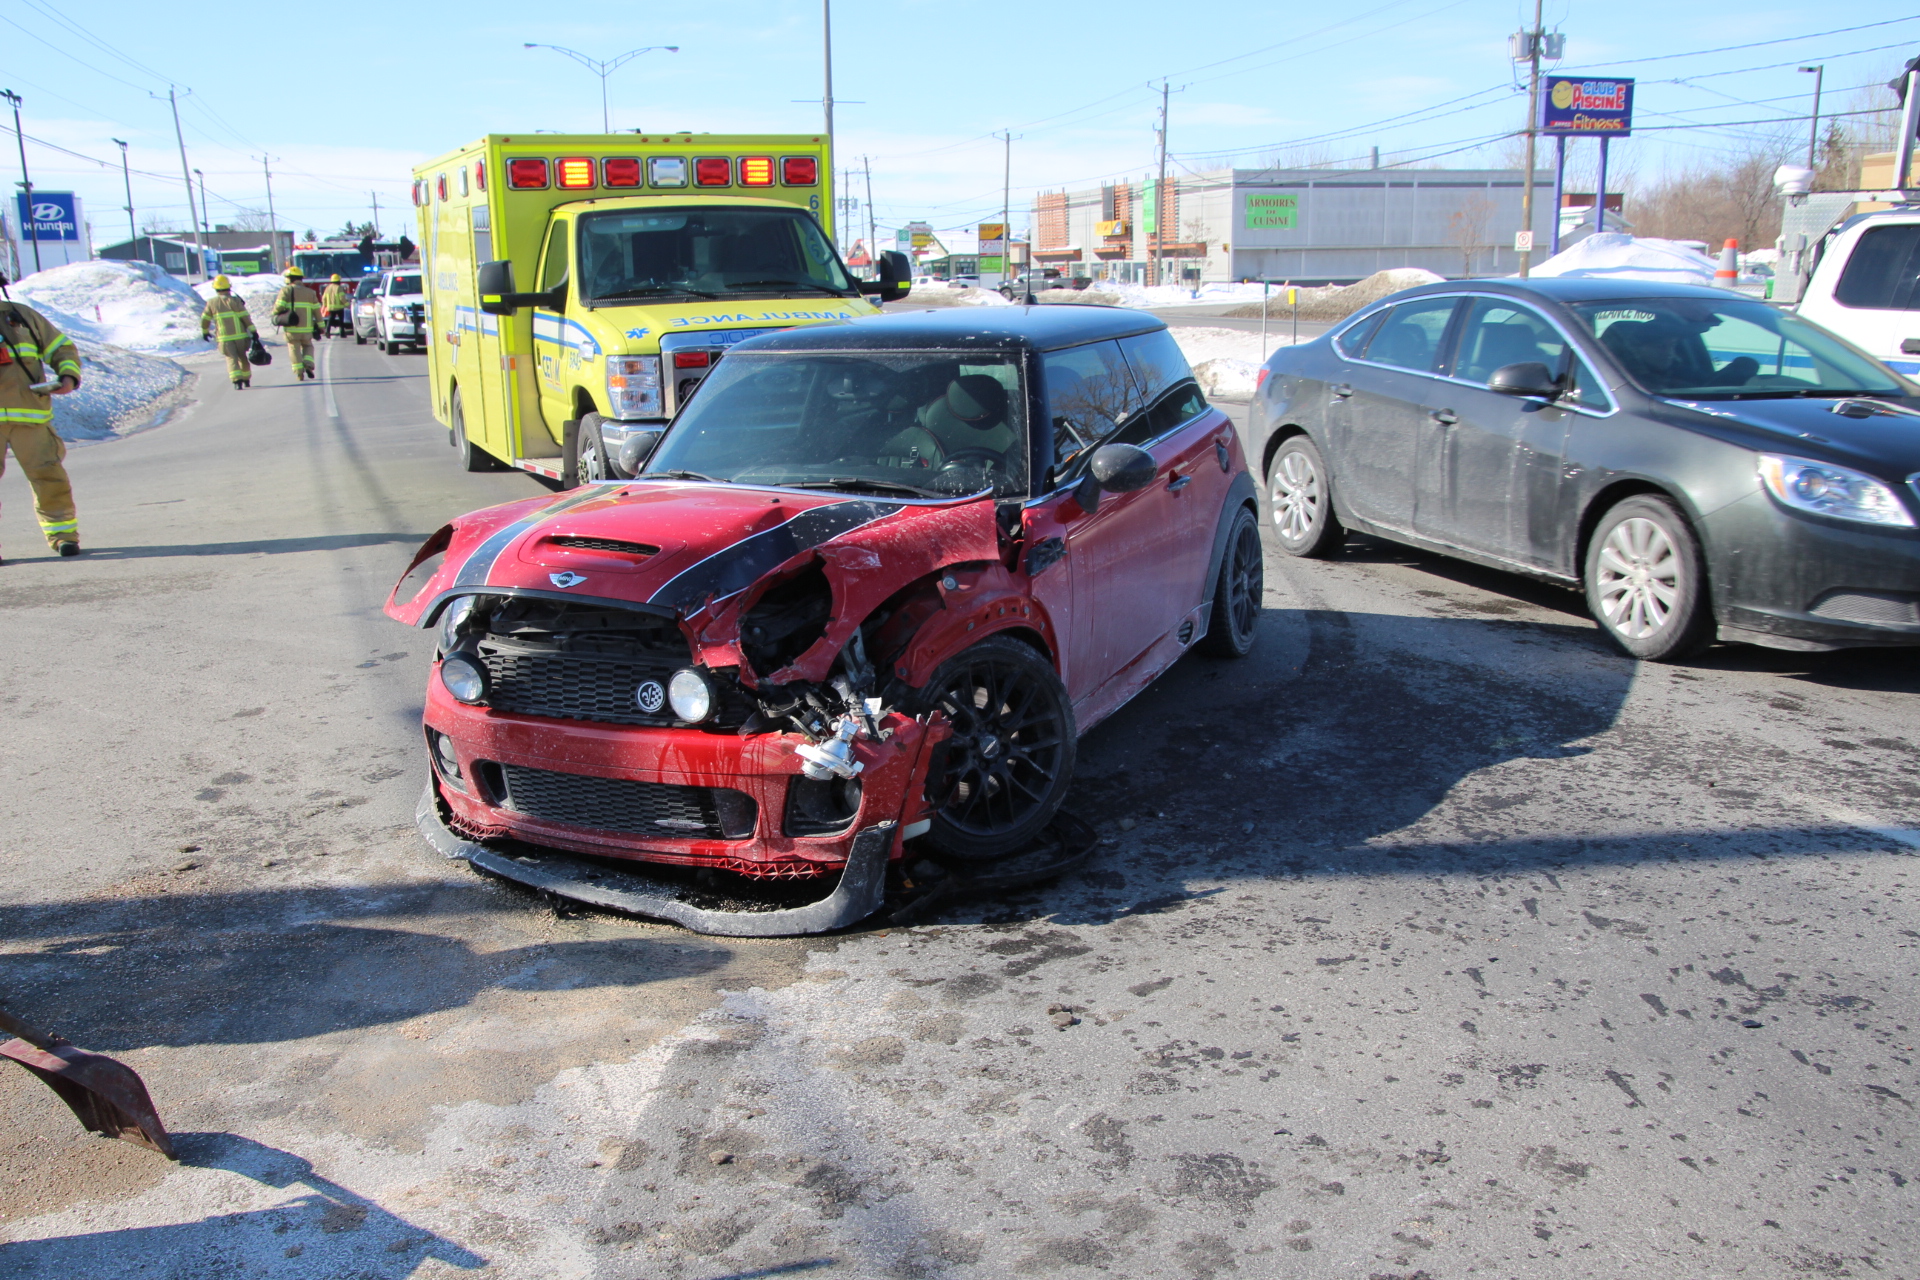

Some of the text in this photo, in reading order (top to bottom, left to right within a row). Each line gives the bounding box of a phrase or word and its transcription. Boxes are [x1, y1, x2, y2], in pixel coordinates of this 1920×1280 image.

[1583, 81, 1616, 96] CLUB
[1571, 84, 1626, 111] PISCINE
[1249, 198, 1296, 207] ARMOIRES
[1253, 216, 1289, 226] CUISINE
[23, 222, 74, 231] HYUNDAI
